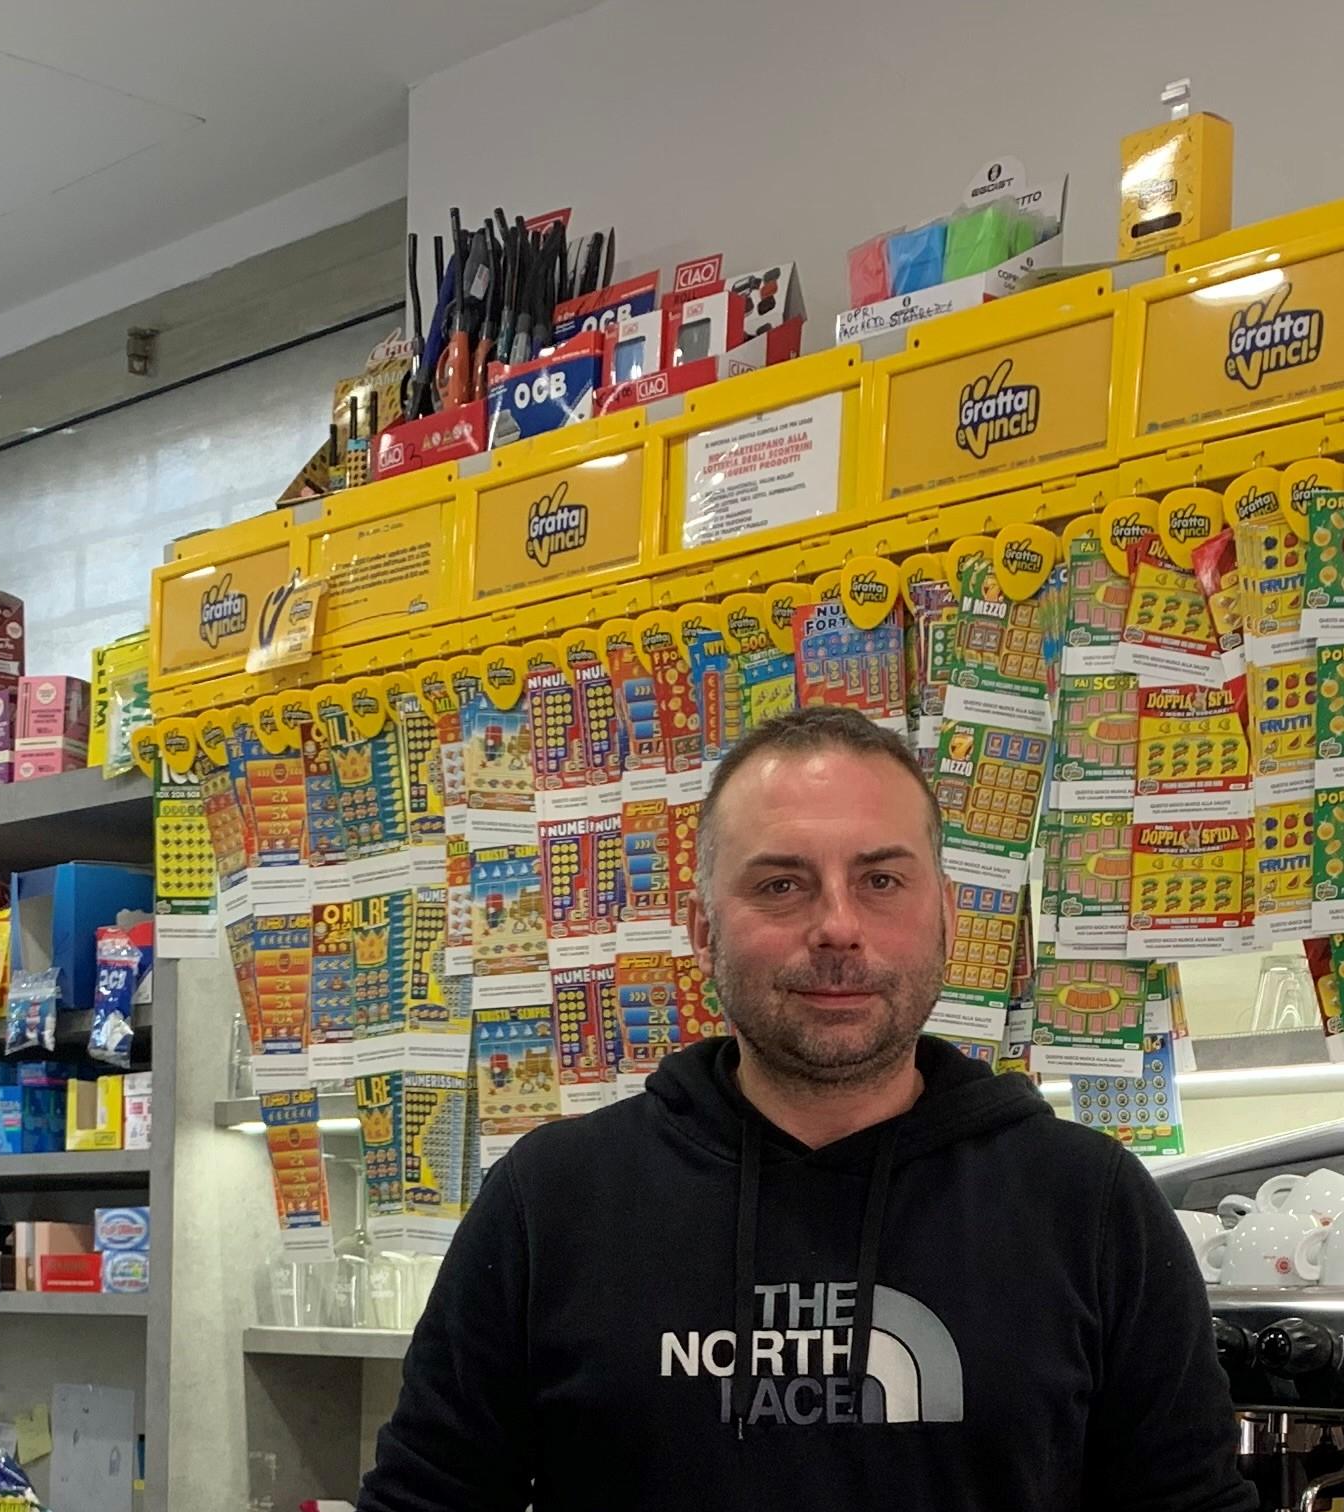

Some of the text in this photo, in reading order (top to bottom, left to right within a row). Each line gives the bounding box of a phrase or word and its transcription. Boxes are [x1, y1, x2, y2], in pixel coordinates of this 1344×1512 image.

[679, 262, 715, 289] CIAO
[1232, 314, 1310, 353] Gratta
[514, 371, 567, 410] OCB
[962, 389, 1028, 425] Gratta
[973, 600, 1007, 618] MEZZO
[1139, 825, 1241, 848] DOPPIA SFIDA
[754, 1282, 858, 1328] THE
[660, 1328, 853, 1377] NORTH
